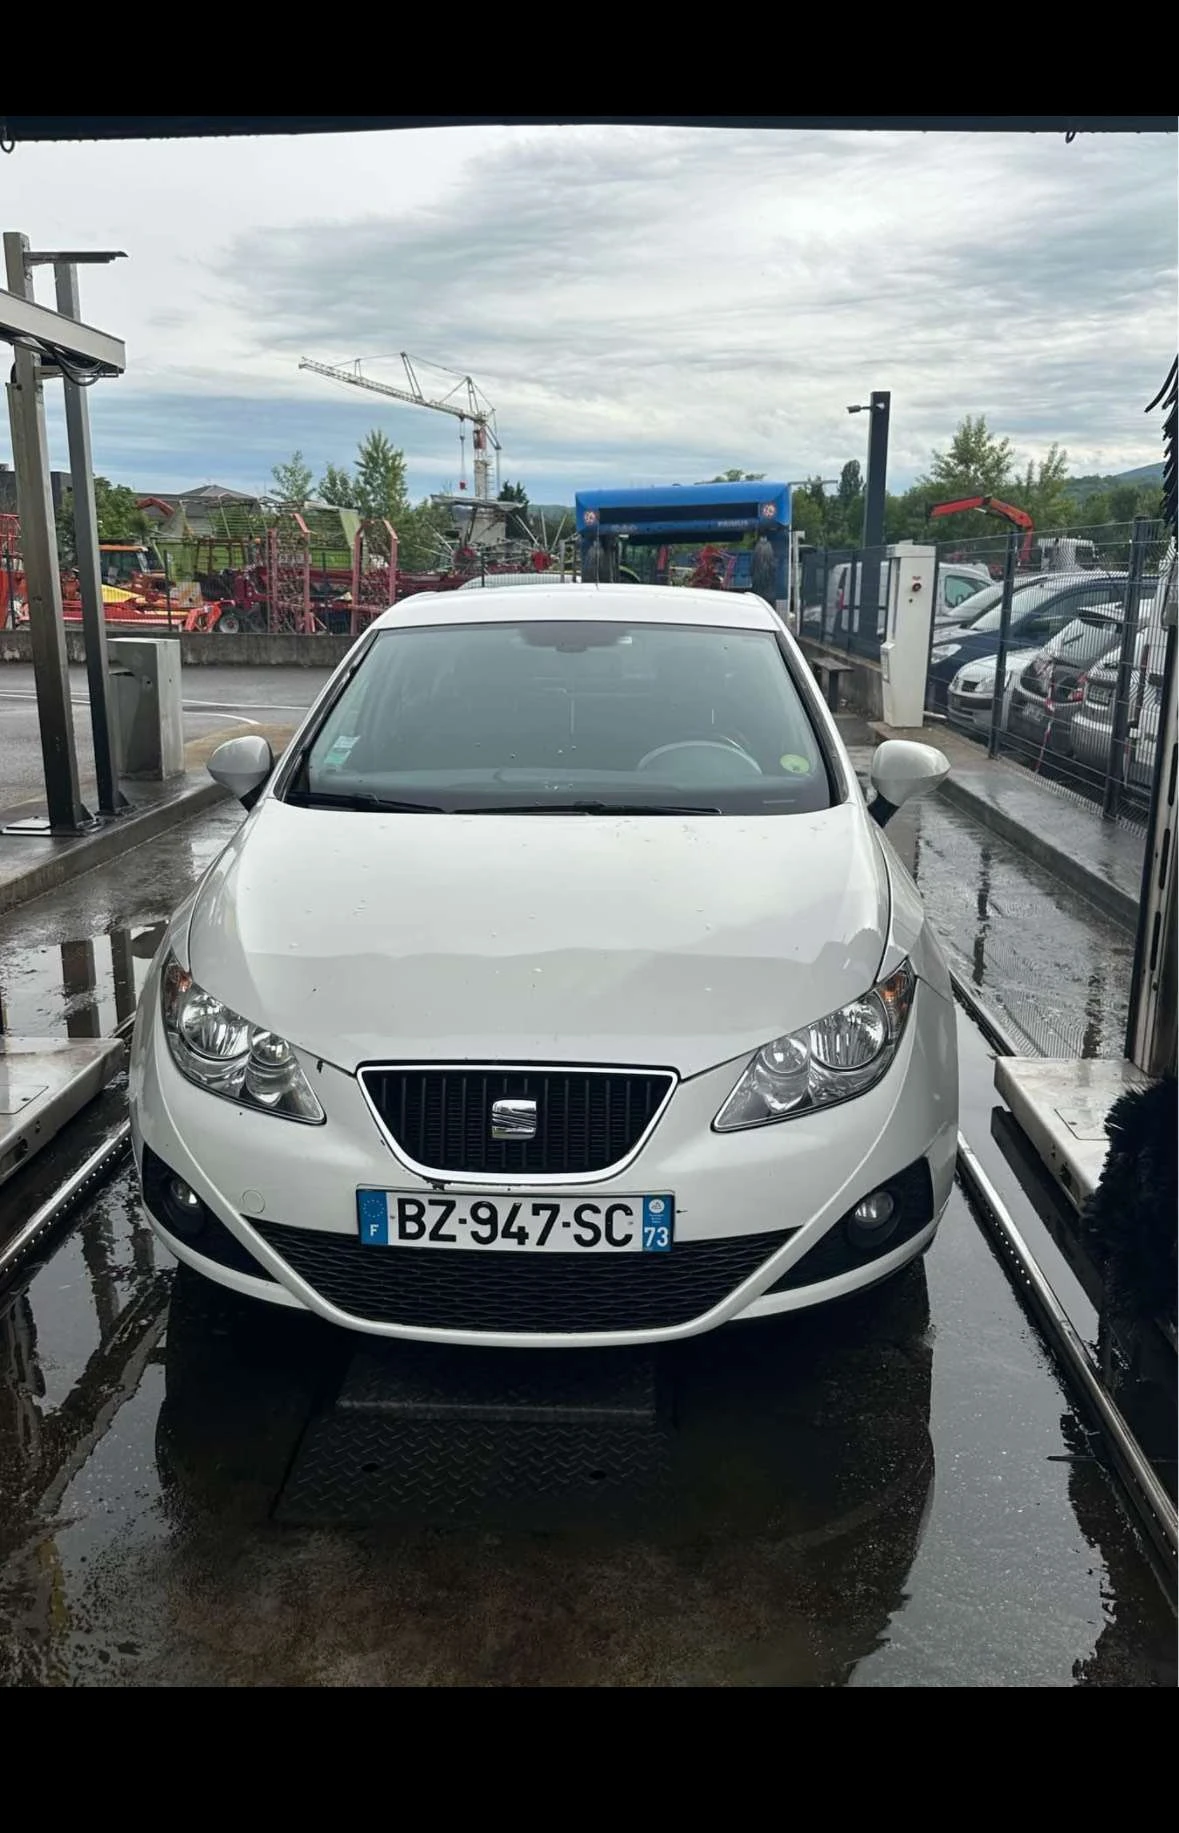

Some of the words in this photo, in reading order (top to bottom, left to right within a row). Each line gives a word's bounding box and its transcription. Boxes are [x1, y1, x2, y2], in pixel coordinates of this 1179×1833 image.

[370, 1224, 379, 1237] F
[397, 1198, 633, 1247] BZ-947-SC
[644, 1226, 669, 1247] 73
